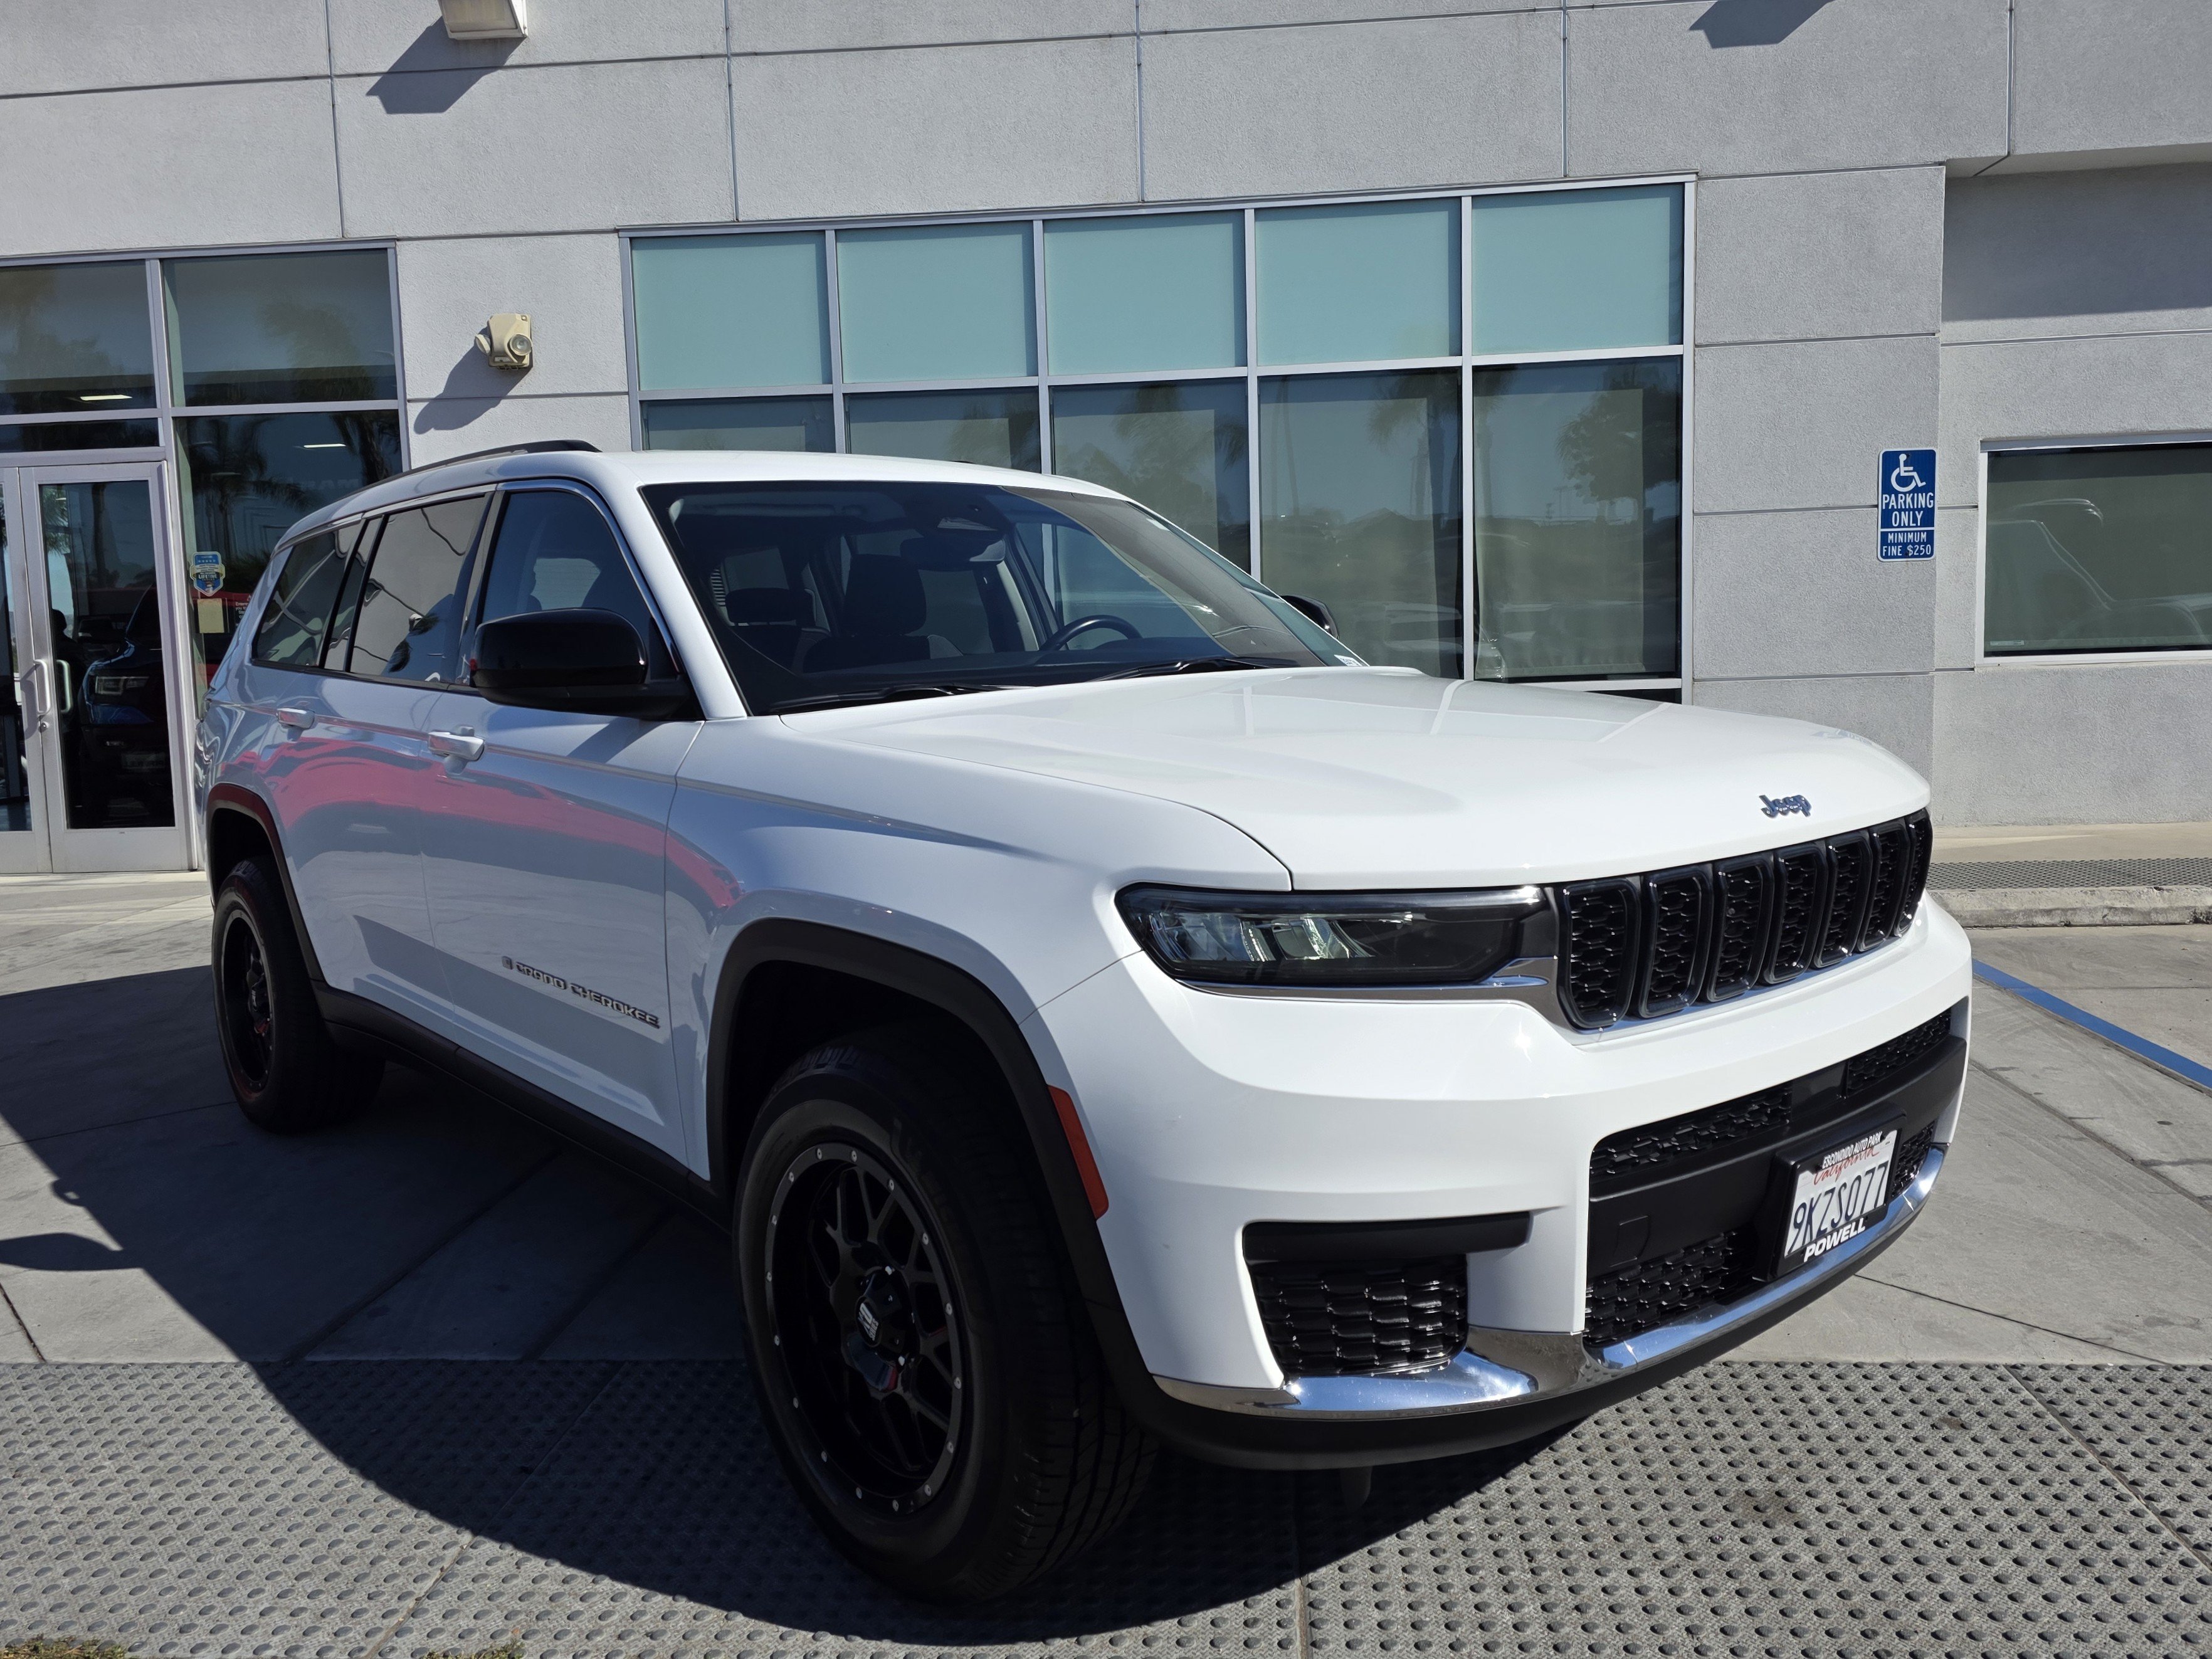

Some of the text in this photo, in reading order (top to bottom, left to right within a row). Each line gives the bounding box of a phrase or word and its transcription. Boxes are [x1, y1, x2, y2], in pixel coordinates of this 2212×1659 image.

[1882, 492, 1934, 510] PARKING
[1892, 510, 1924, 527] ONLY
[1888, 532, 1927, 544] MINIMUM
[1882, 544, 1932, 557] FINE $250
[1759, 794, 1812, 818] Jeep
[515, 961, 660, 1029] GRAND CHEROKEE
[1853, 1137, 1868, 1155] AUTO
[1867, 1130, 1883, 1148] PARK
[1788, 1160, 1890, 1254] 9KZS077
[1803, 1217, 1866, 1263] POWELL
